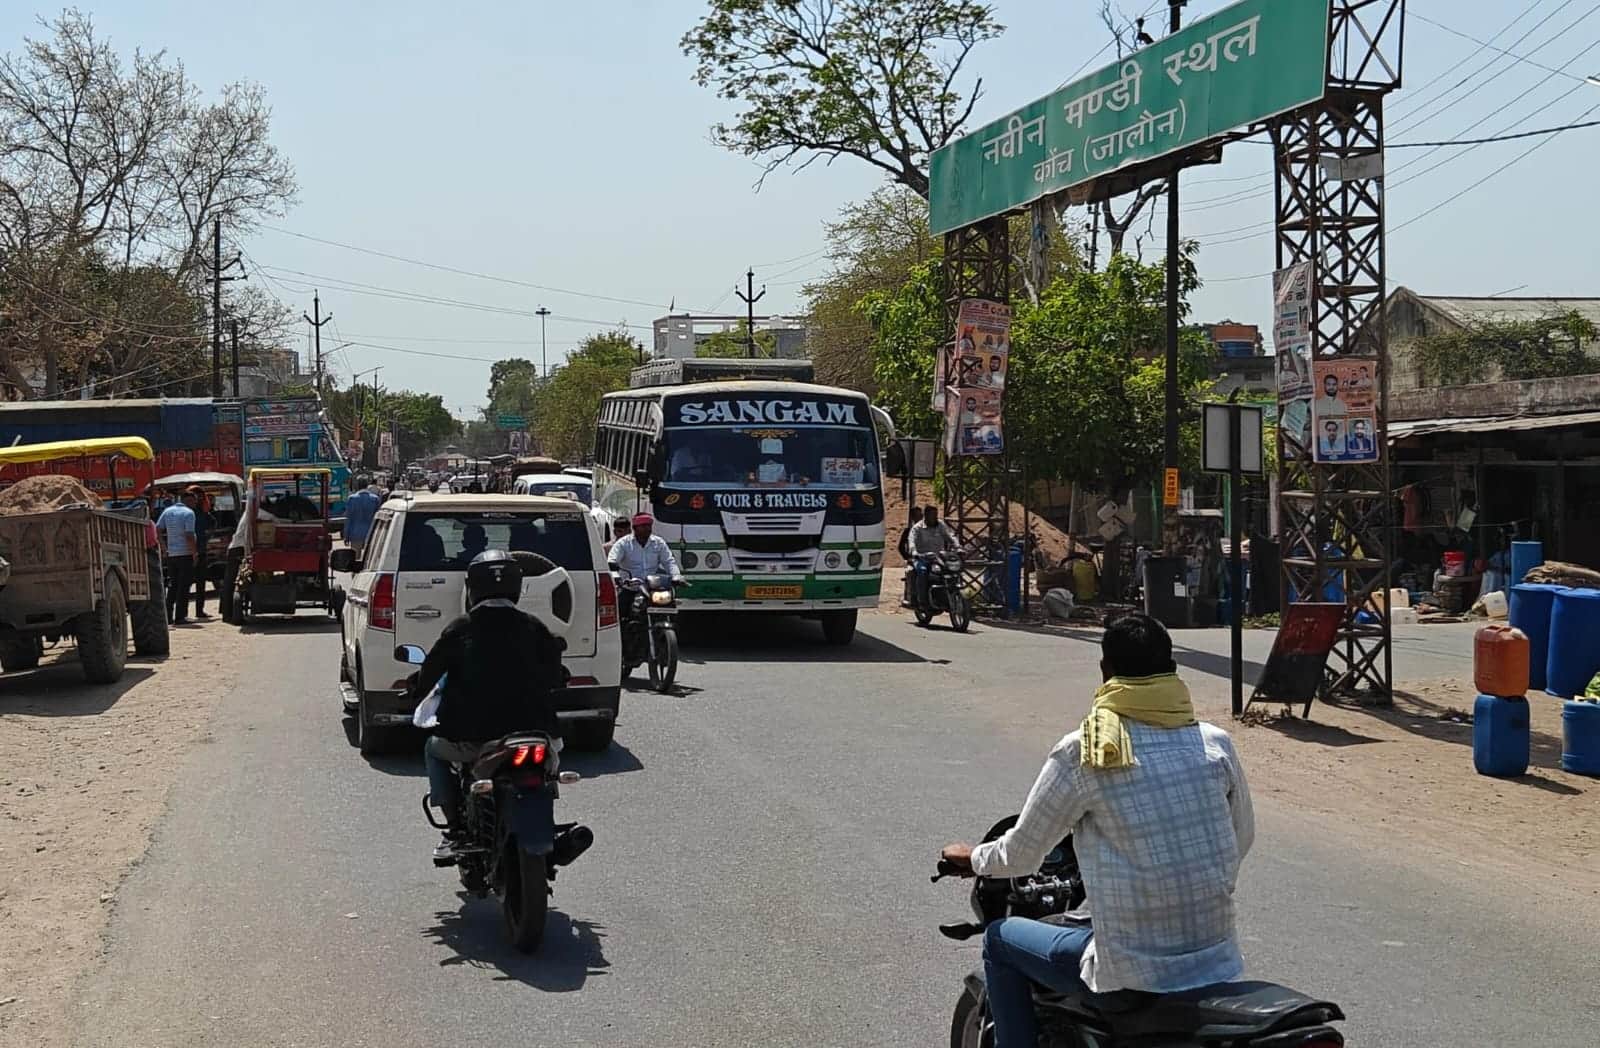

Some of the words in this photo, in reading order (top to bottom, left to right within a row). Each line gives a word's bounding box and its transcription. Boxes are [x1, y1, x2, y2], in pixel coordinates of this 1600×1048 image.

[982, 113, 1045, 165] नवीन
[1064, 59, 1142, 129] मण्डी
[1163, 14, 1261, 86] स्थल
[1033, 145, 1073, 184] कोंच
[1083, 98, 1187, 173] (जालौन)
[680, 400, 859, 425] SANGAM
[714, 493, 750, 507] TOUR
[753, 493, 763, 507] &
[765, 493, 828, 507] TRAVELS
